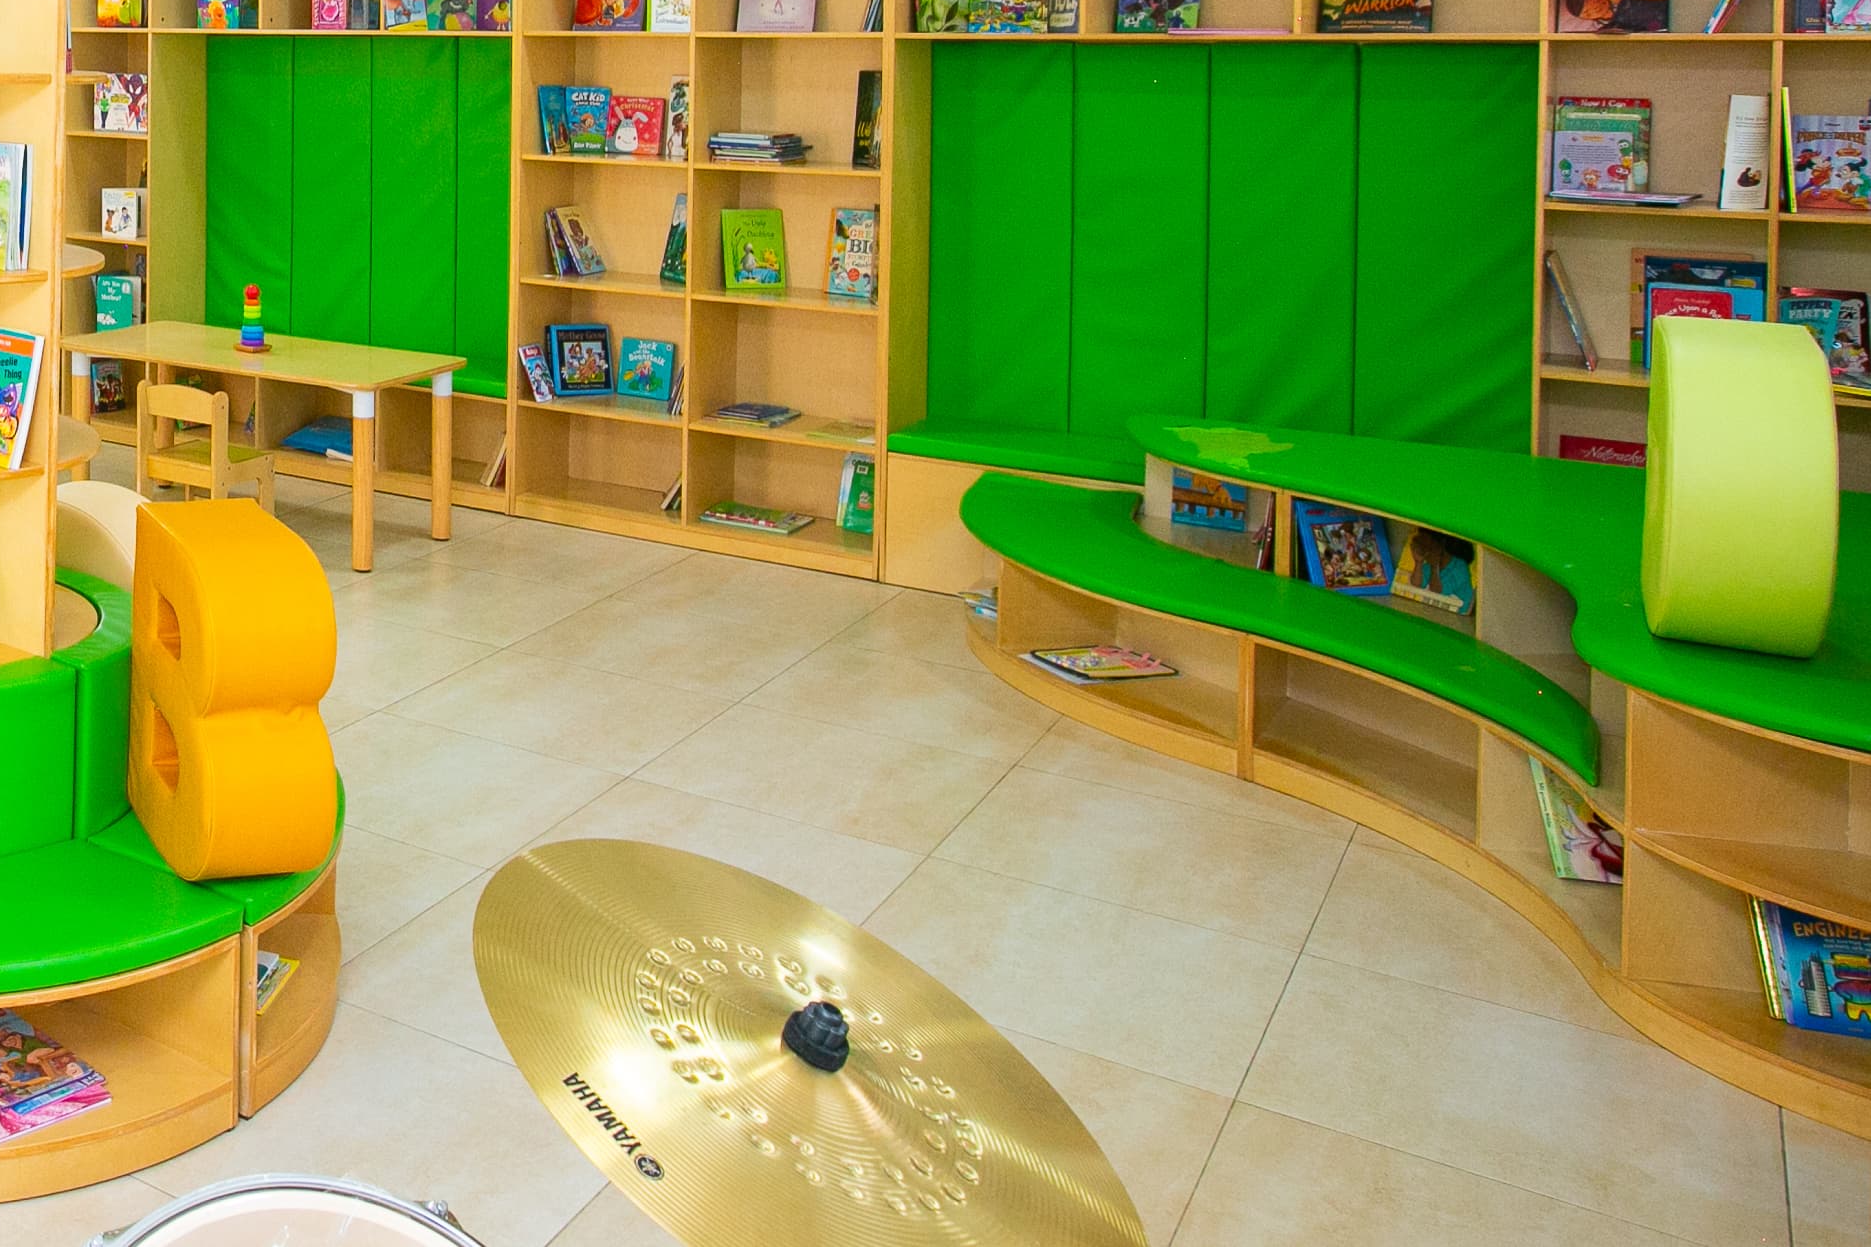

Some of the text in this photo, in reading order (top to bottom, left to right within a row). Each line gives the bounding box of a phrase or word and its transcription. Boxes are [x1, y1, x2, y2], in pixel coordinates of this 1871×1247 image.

[572, 92, 588, 101] CAT
[4, 369, 22, 380] Thing
[563, 1072, 642, 1156] YAMAHA
